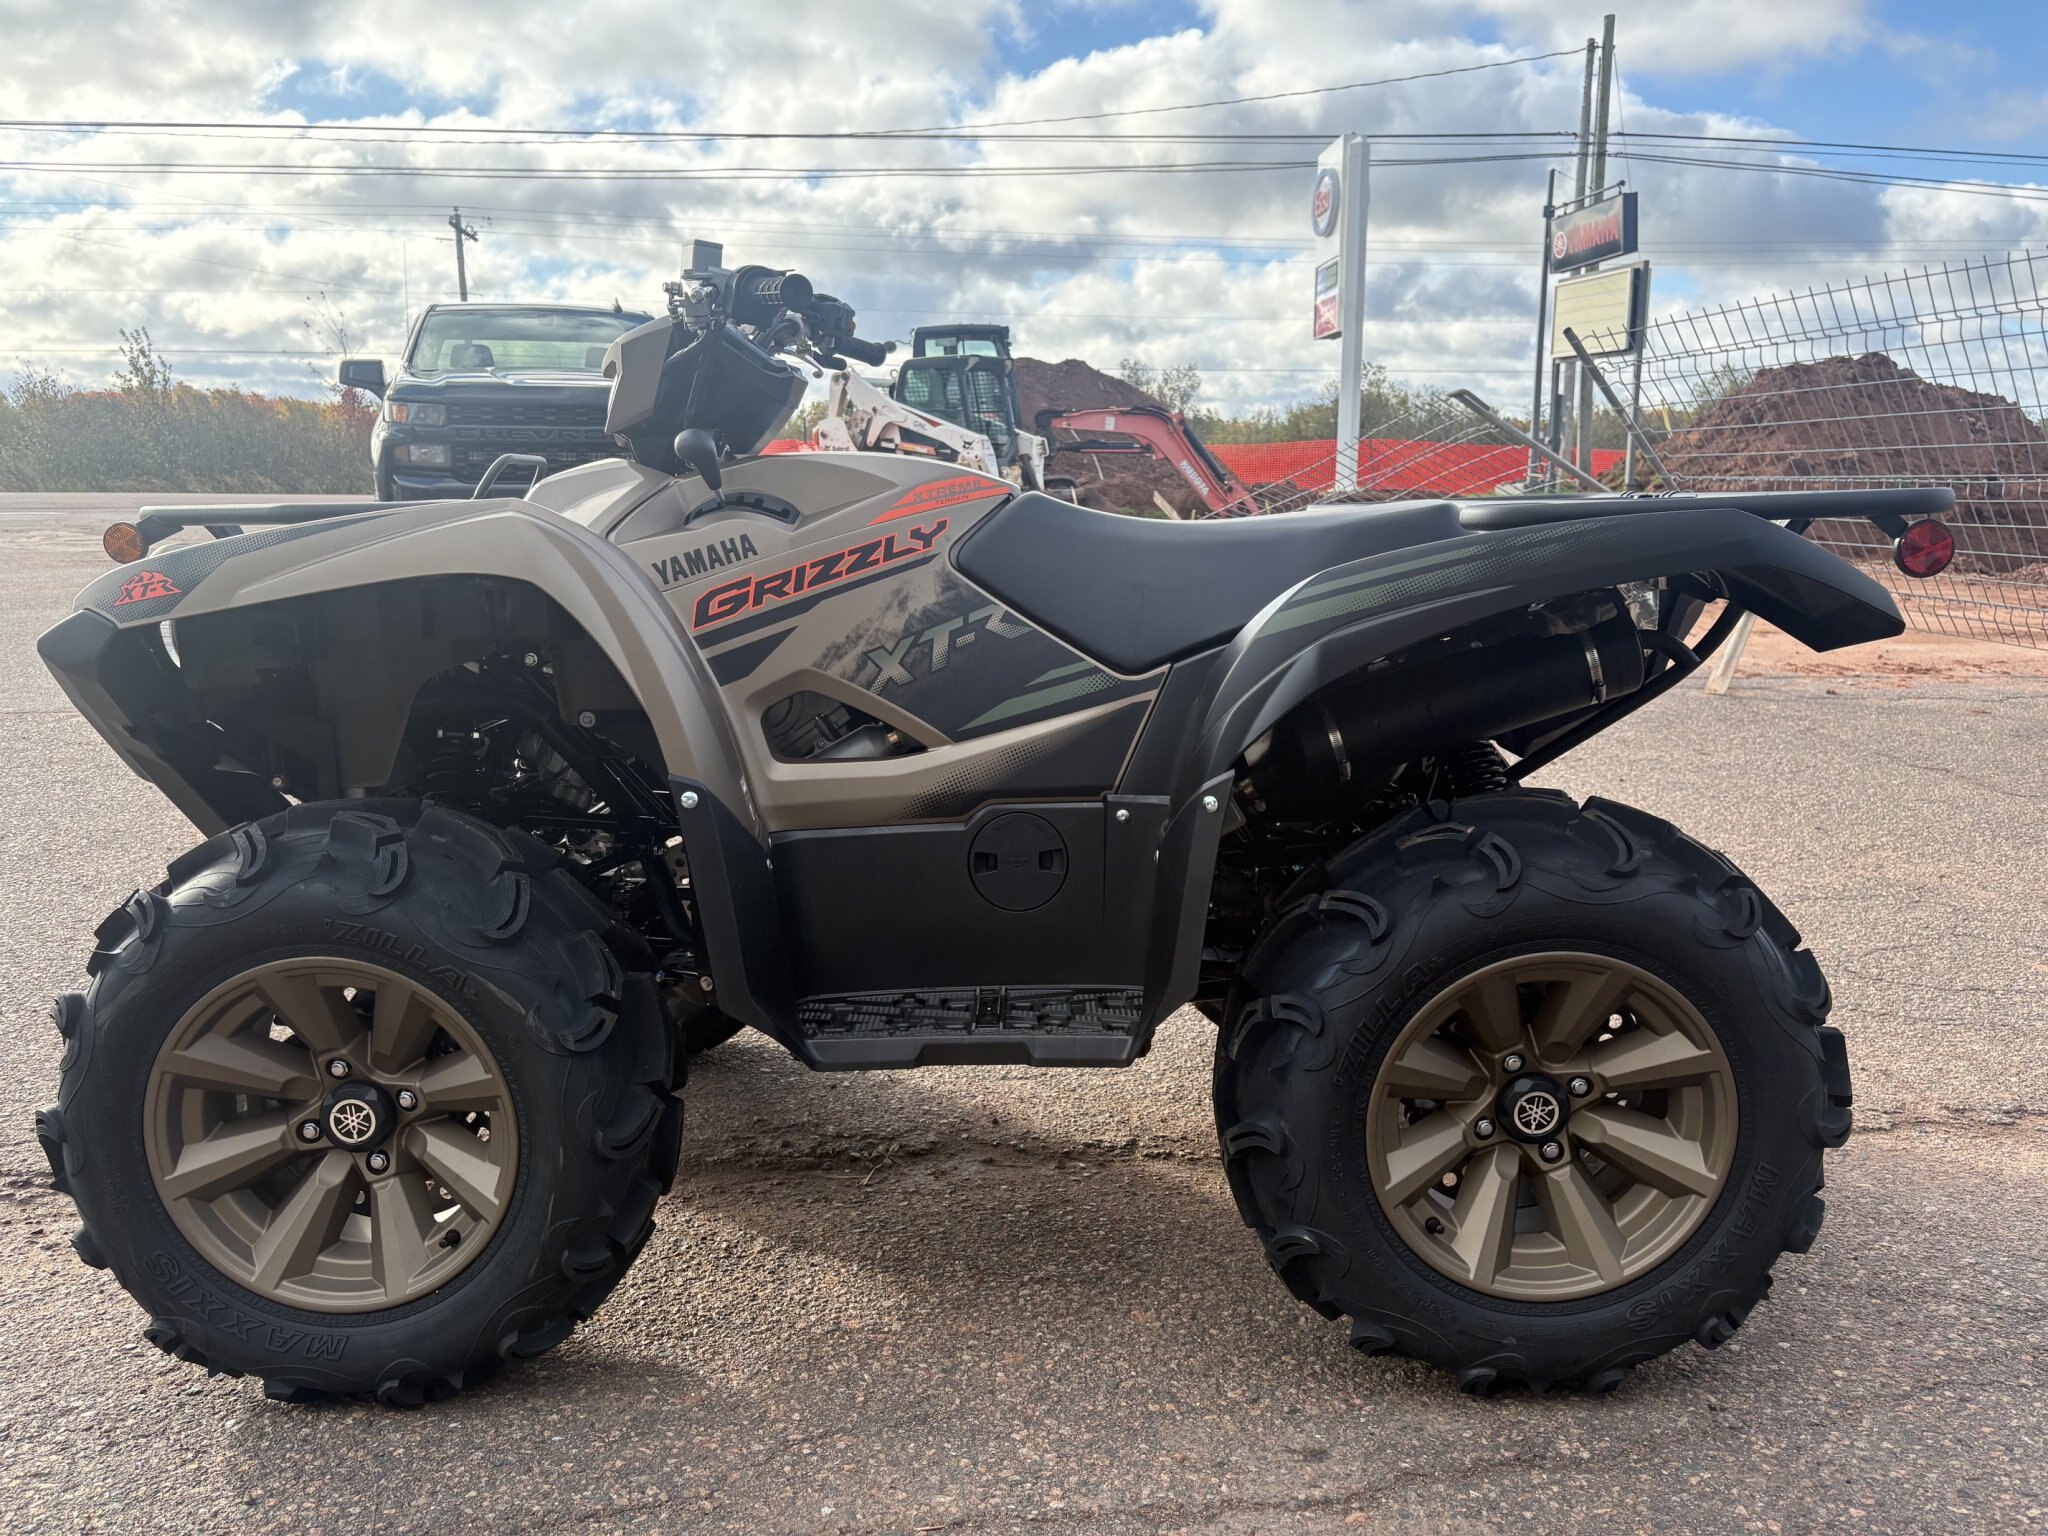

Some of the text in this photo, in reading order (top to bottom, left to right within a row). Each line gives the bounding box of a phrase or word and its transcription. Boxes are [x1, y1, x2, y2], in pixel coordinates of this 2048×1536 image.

[1568, 213, 1618, 256] YAMAHA
[913, 479, 981, 502] XTREME
[1180, 460, 1209, 496] KUBOTA
[936, 494, 969, 506] TERRAIN
[651, 533, 759, 586] YAMAHA
[692, 517, 949, 632] GRIZZLY
[120, 579, 175, 601] XT-R
[1625, 1160, 1781, 1332] MAXXIS
[142, 1248, 350, 1362] MAXXIS
